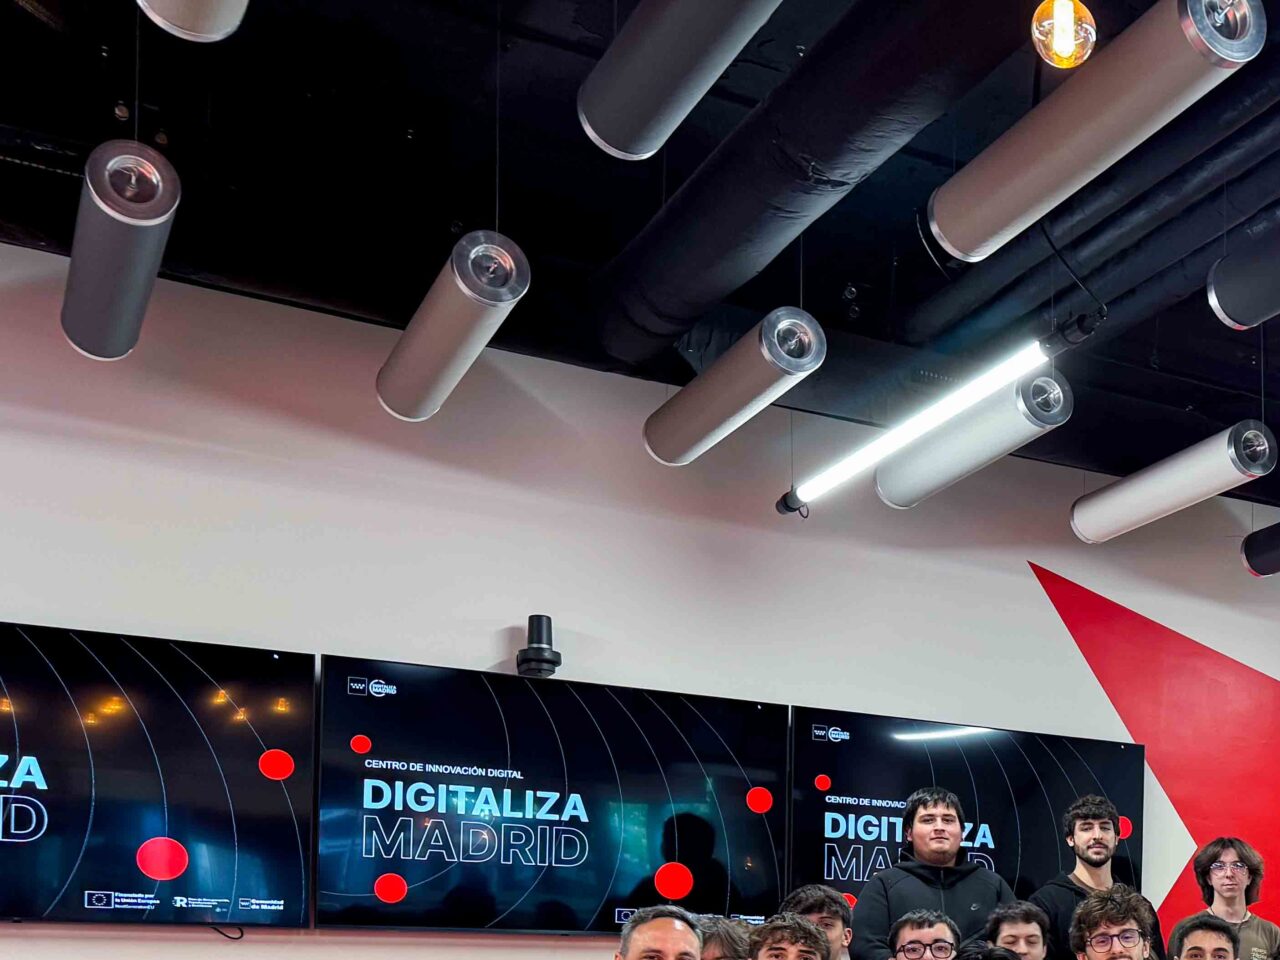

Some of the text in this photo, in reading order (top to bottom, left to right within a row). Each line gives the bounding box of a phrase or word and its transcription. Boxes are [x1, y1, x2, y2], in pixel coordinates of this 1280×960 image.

[365, 759, 524, 780] CENTRO DE INNOVACIÓN DIGITAL
[363, 778, 590, 823] DIGITALIZA
[825, 795, 907, 809] CENTRO DE INNOVAC
[362, 815, 589, 867] MADRID
